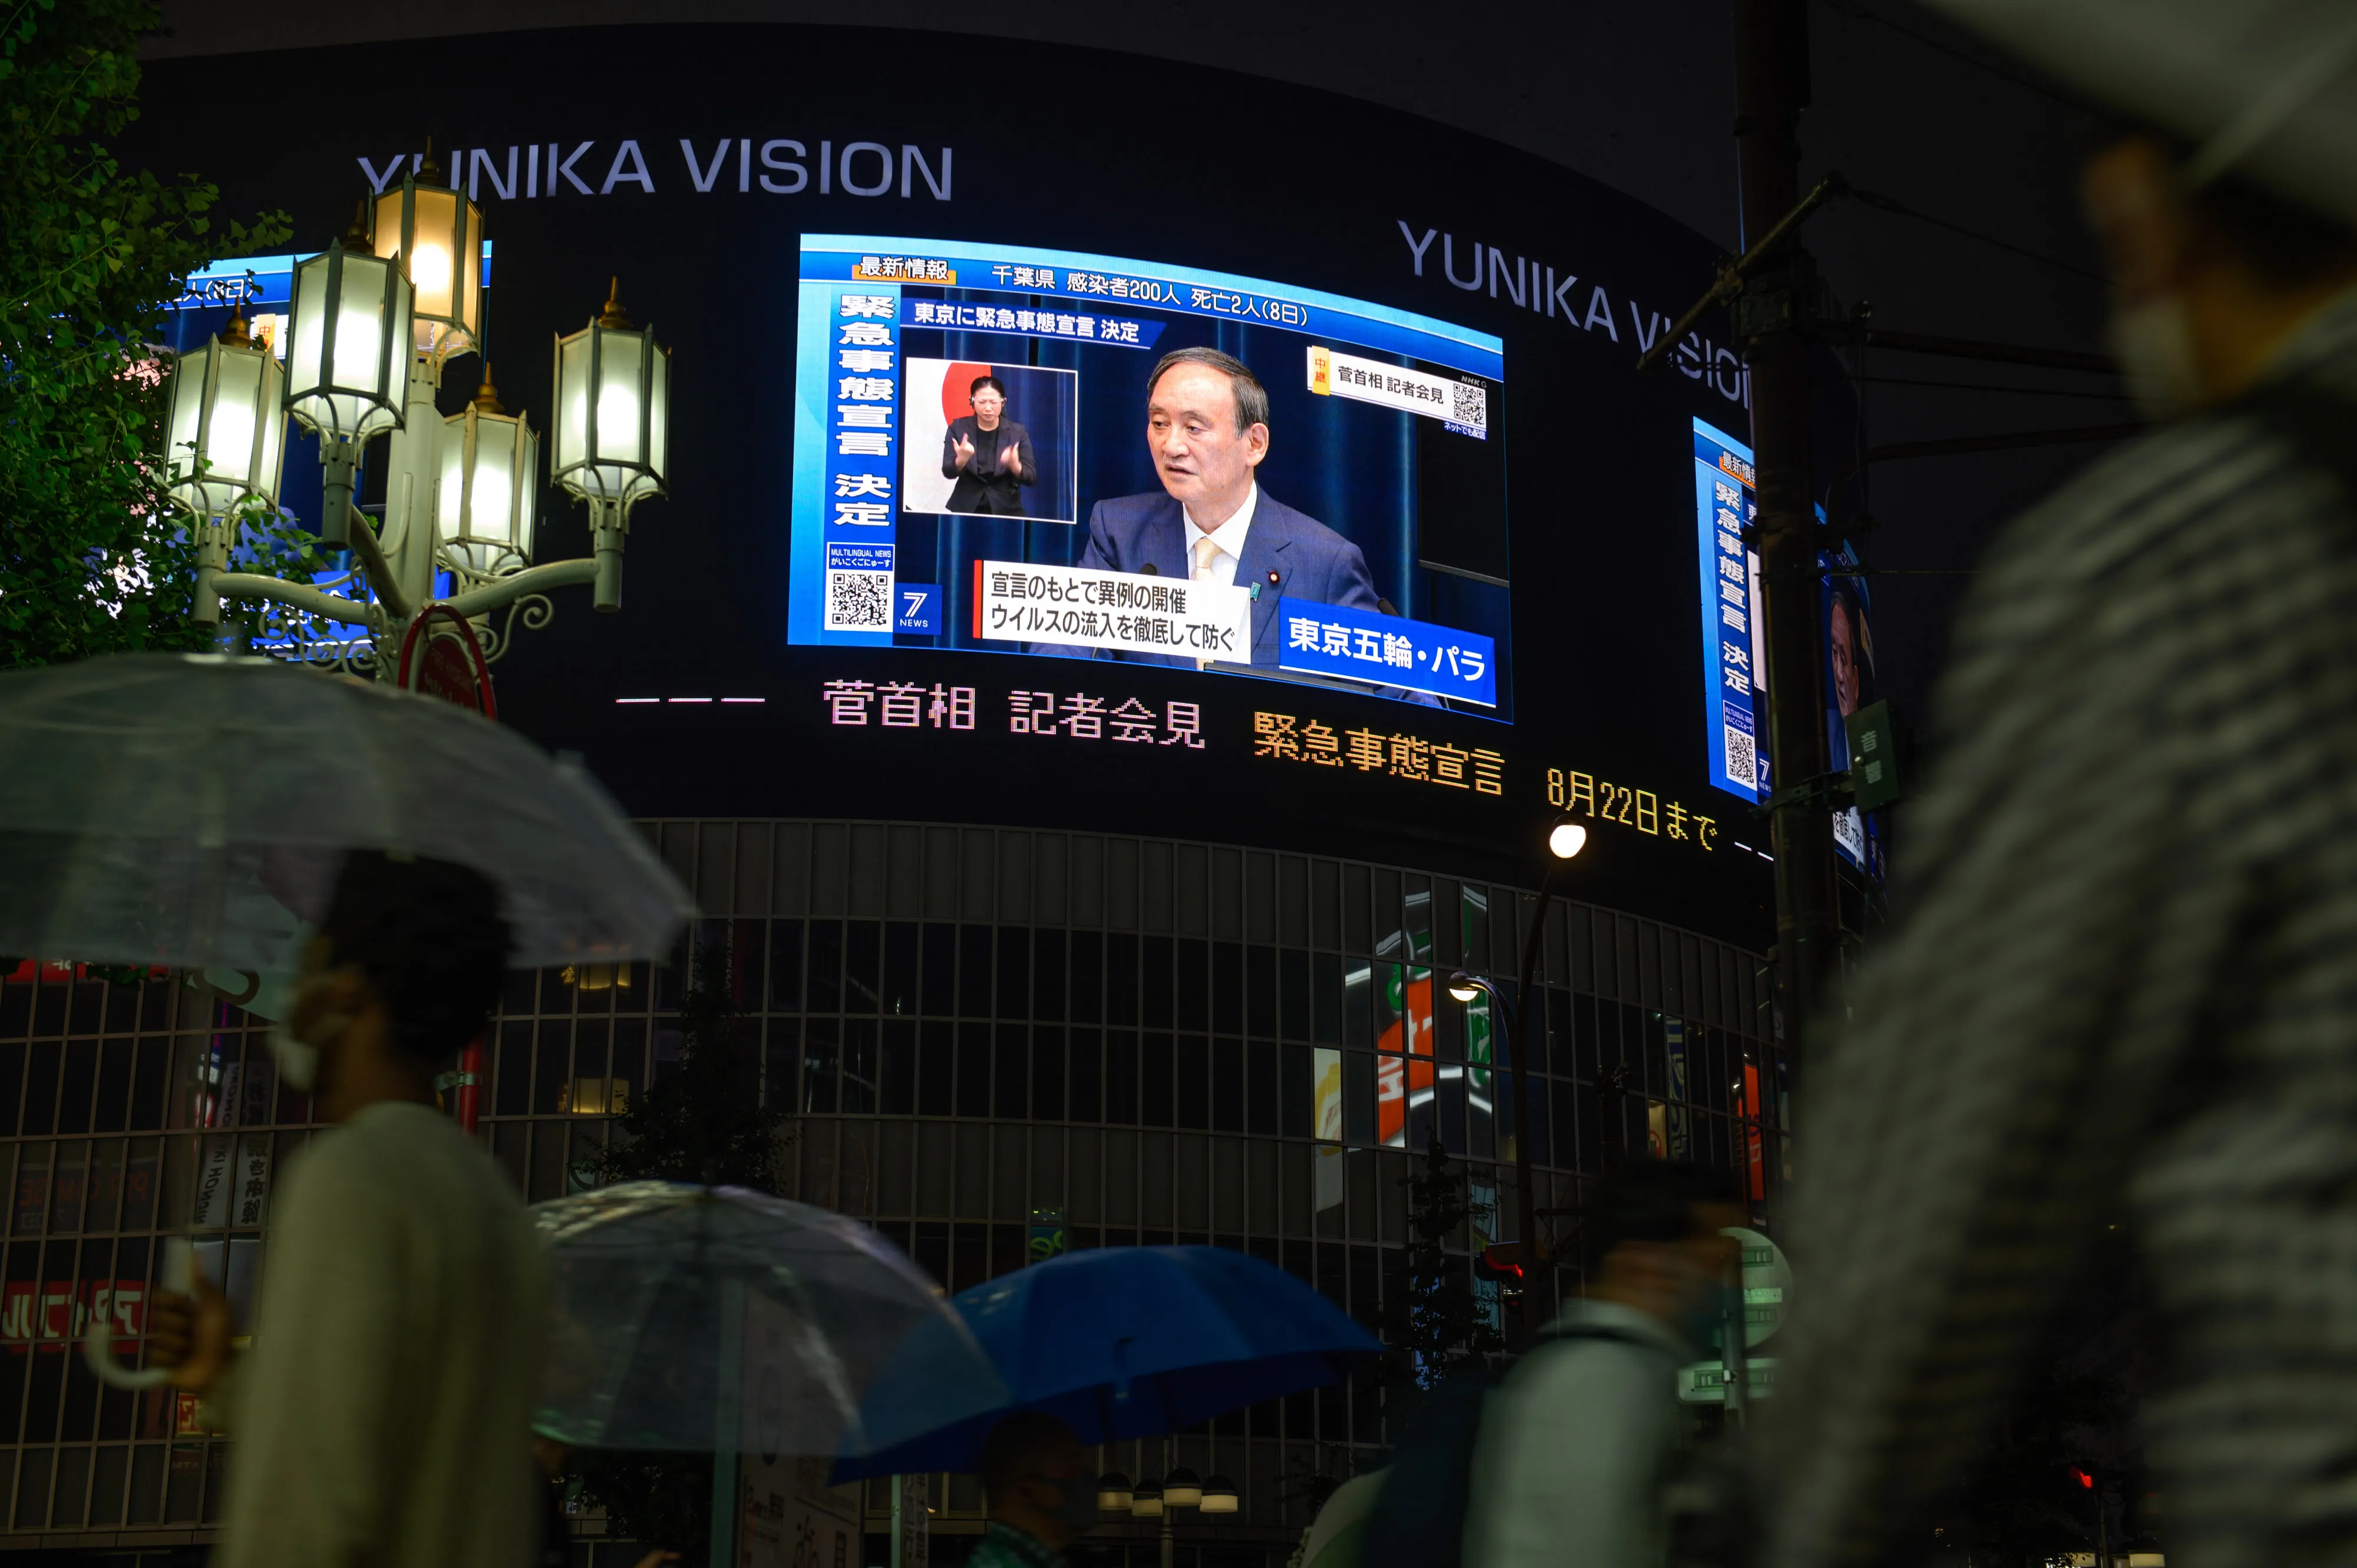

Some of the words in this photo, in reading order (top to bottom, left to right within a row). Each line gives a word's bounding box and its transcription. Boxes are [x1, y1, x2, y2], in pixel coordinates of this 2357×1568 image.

[679, 138, 952, 202] VISION
[860, 256, 949, 281] 最新情報
[1397, 219, 1619, 344] YUNIKA
[991, 265, 1056, 290] 千葉県
[1067, 272, 1181, 306] 感染者200人
[1190, 287, 1308, 327] 死亡2人(8日)
[915, 302, 1095, 338] 東京に緊急事態宣言
[1101, 321, 1140, 344] 決定
[836, 294, 896, 457] 緊急事態宣言
[1315, 357, 1326, 384] 中継
[1338, 365, 1383, 390] 菅首相
[1387, 376, 1444, 404] 記者会見
[1461, 375, 1480, 386] NHK
[1481, 381, 1487, 389] G
[1444, 421, 1486, 440] ネットでも配信
[833, 473, 892, 527] 決定
[831, 548, 873, 558] MULTILINGUAL
[874, 550, 892, 558] NEWS
[831, 557, 891, 567] がいこくごにゅーす
[1715, 479, 1747, 634] 緊急事態宣言
[903, 592, 928, 618] 7
[991, 570, 1187, 615] 宣言のもとで異例の開催
[899, 619, 929, 628] NEWS
[991, 603, 1235, 652] ウイルスの流入を徹底して防ぐ
[1288, 617, 1485, 681] 東京五輪・パラ
[1722, 640, 1750, 696] 決定
[823, 679, 976, 729] 菅首相
[1008, 690, 1206, 749] 記者会見
[1253, 711, 1506, 796] 緊急事態宣言
[1547, 768, 1718, 851] 8月22日まで
[1759, 781, 1772, 793] NEWS
